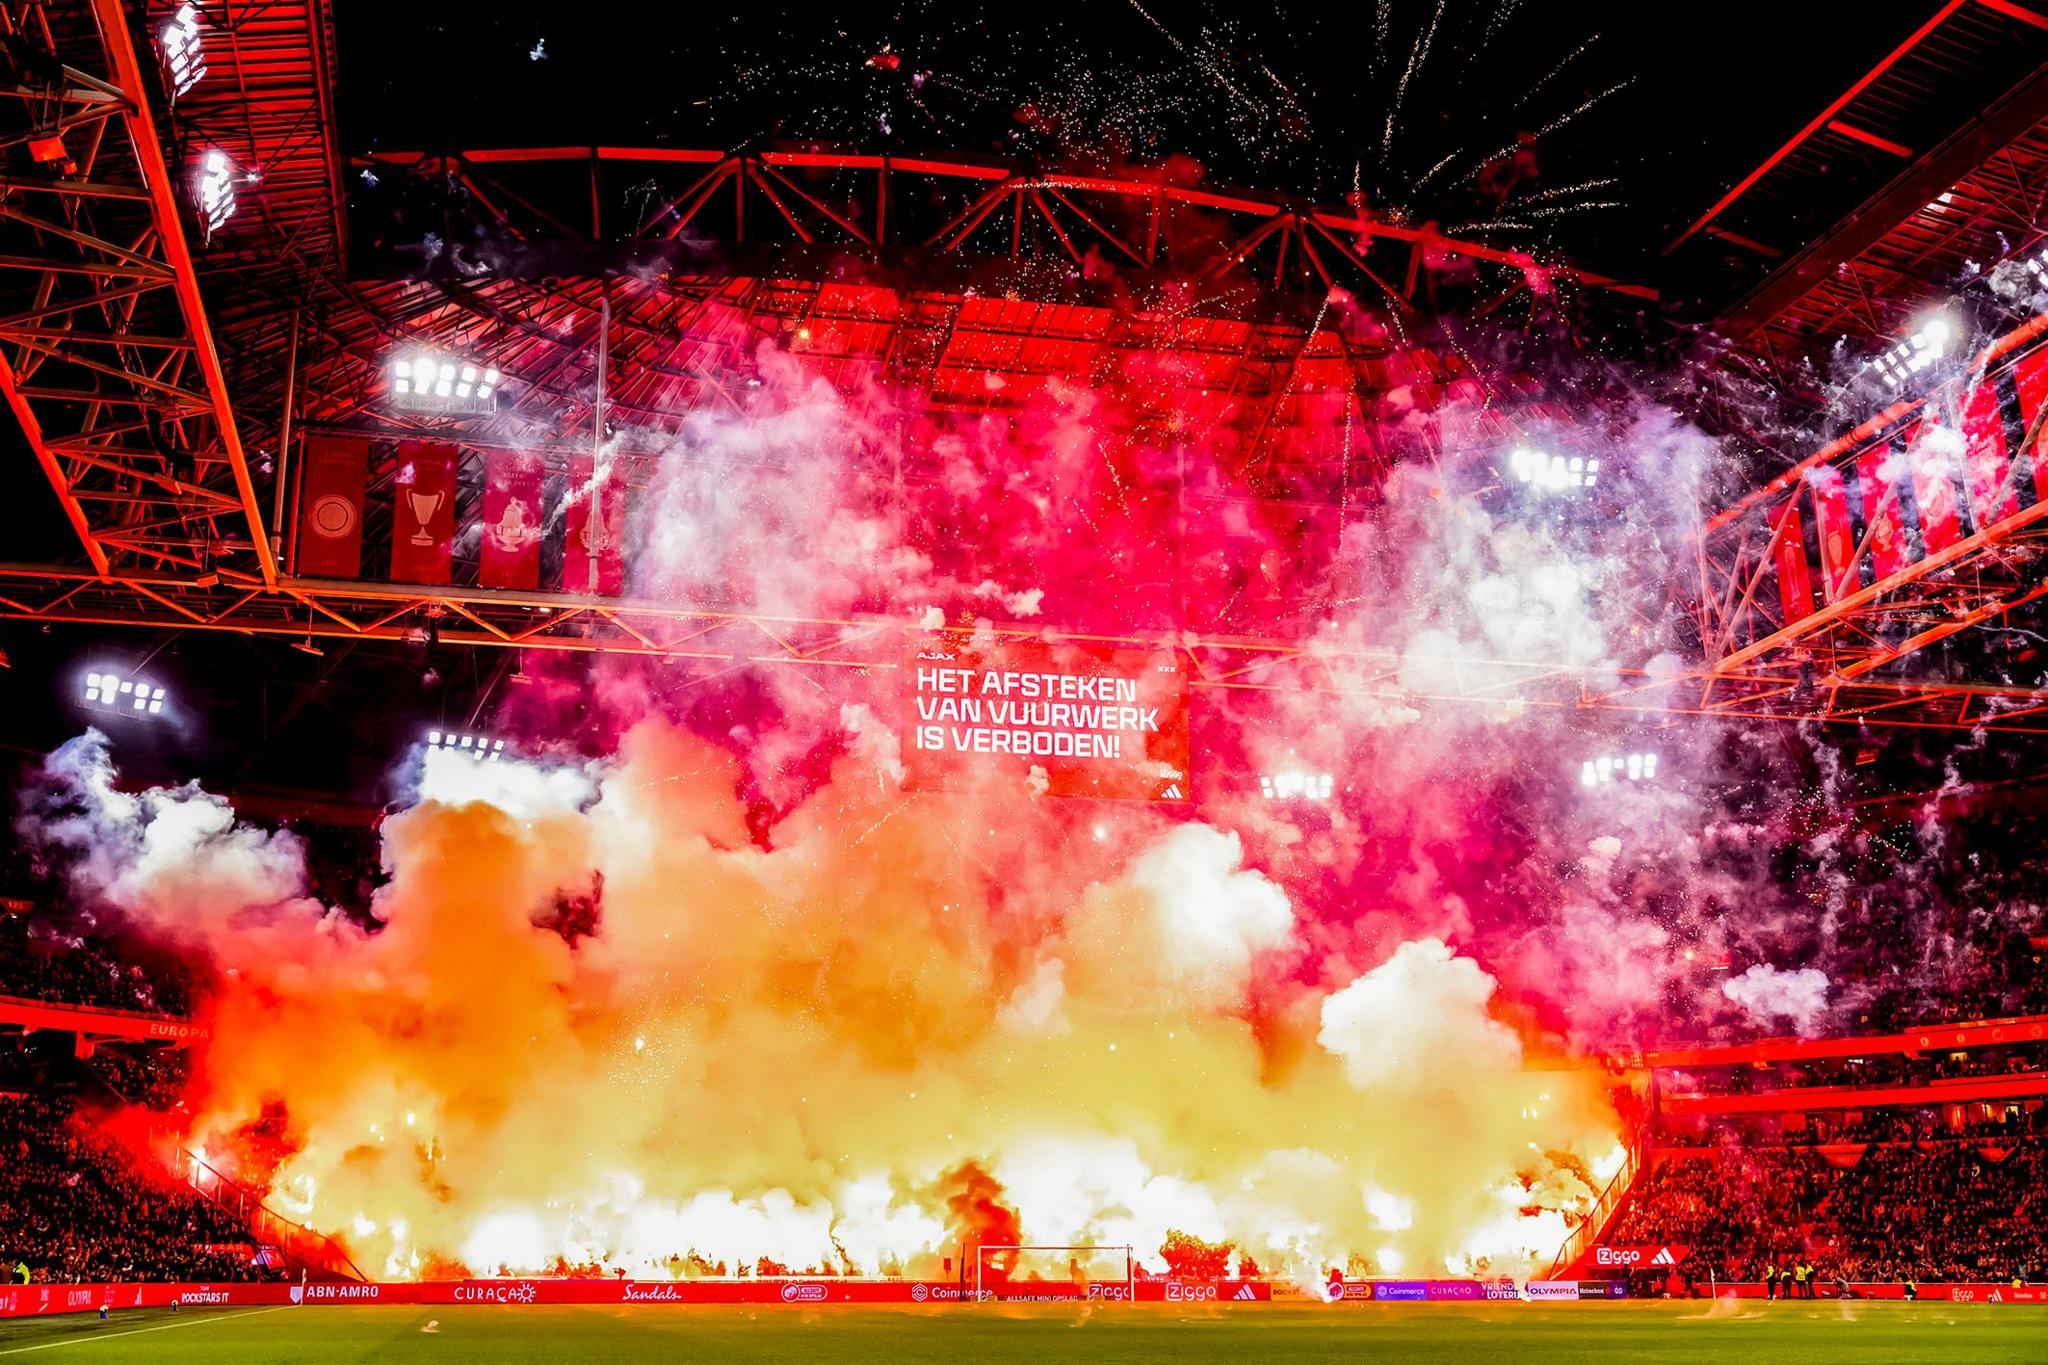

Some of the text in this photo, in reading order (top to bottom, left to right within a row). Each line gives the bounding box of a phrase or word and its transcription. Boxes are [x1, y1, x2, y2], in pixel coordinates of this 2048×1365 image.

[917, 652, 955, 661] AJAX
[917, 667, 1136, 701] HET AFSTEKEN
[917, 696, 1159, 731] VAN VUURWERK
[917, 725, 1120, 758] IS VERBODEN!
[150, 1024, 209, 1039] EUROPA
[181, 1292, 229, 1303] ROCKSTARS IT
[623, 1283, 682, 1300] Sandals
[1389, 1287, 1425, 1295] Coinmerce
[1530, 1287, 1577, 1295] OLYMPIA
